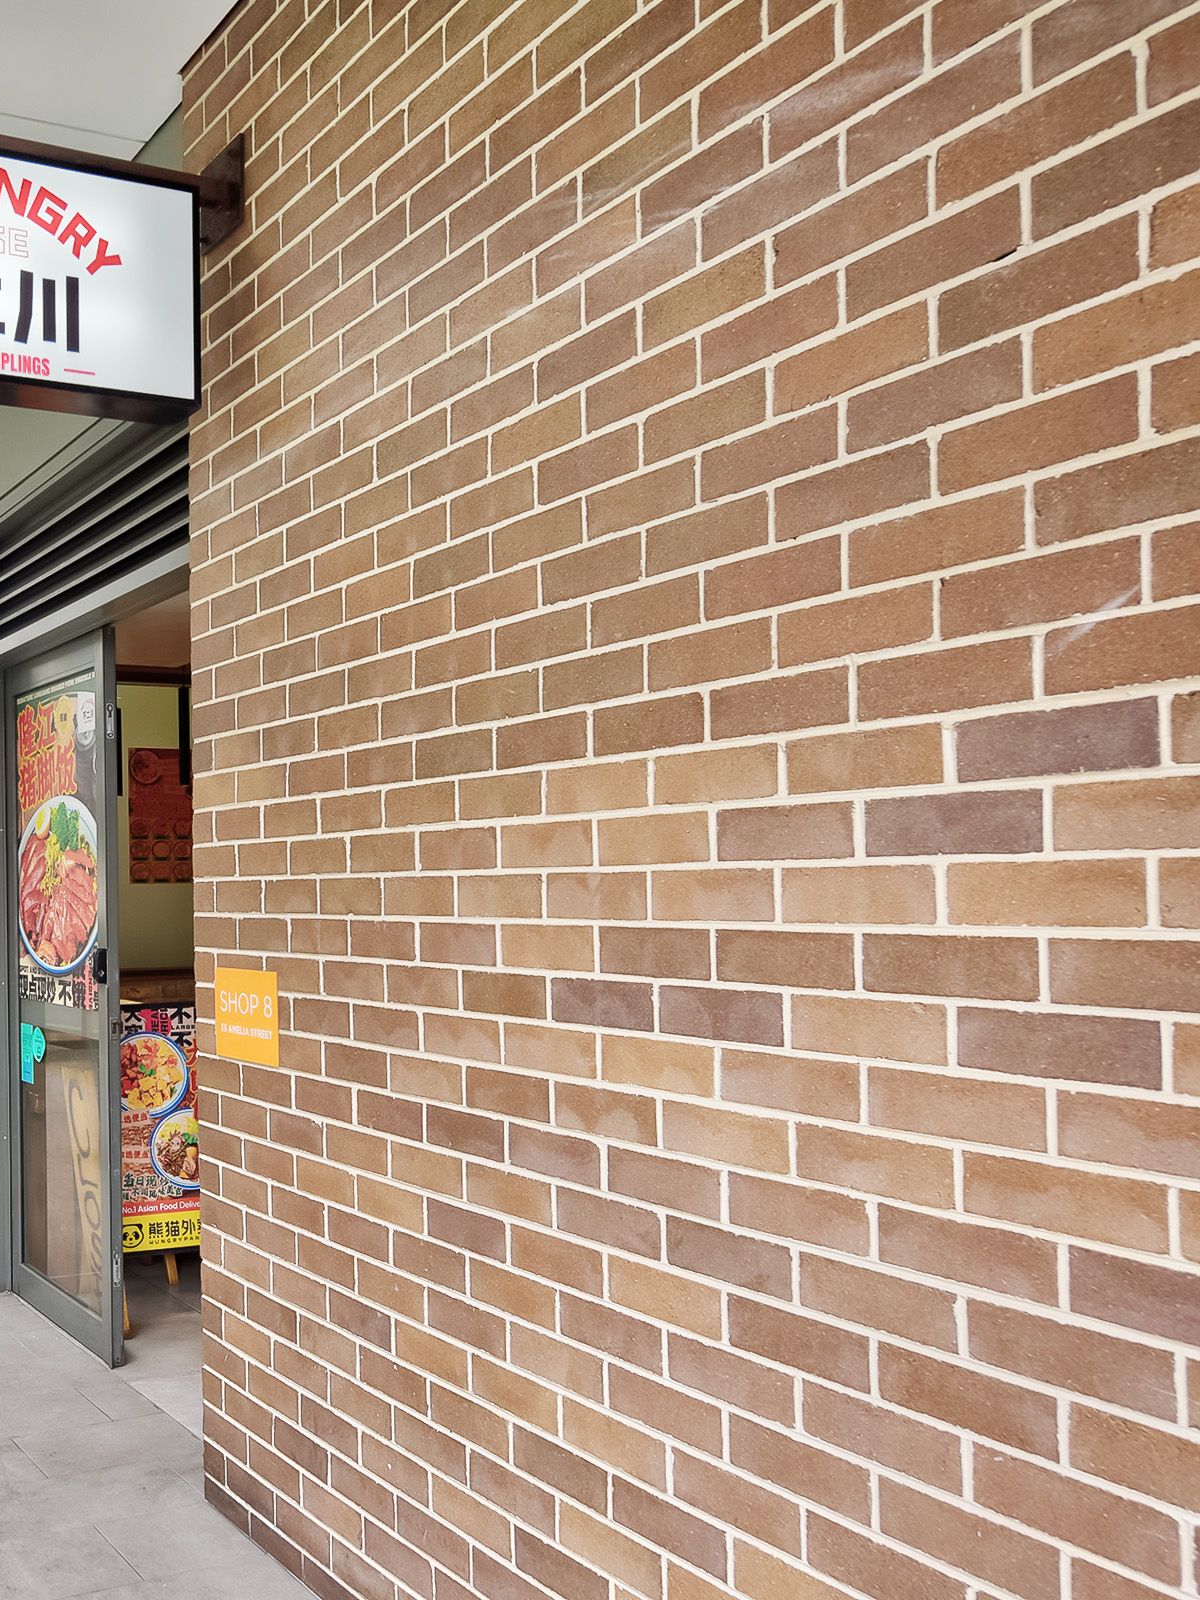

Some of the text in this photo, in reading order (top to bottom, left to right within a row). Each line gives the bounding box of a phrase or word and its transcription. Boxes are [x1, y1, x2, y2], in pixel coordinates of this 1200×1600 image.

[220, 990, 273, 1018] SHOP 8
[250, 1027, 272, 1040] STREET
[138, 1204, 158, 1213] Asian
[160, 1201, 178, 1211] Food
